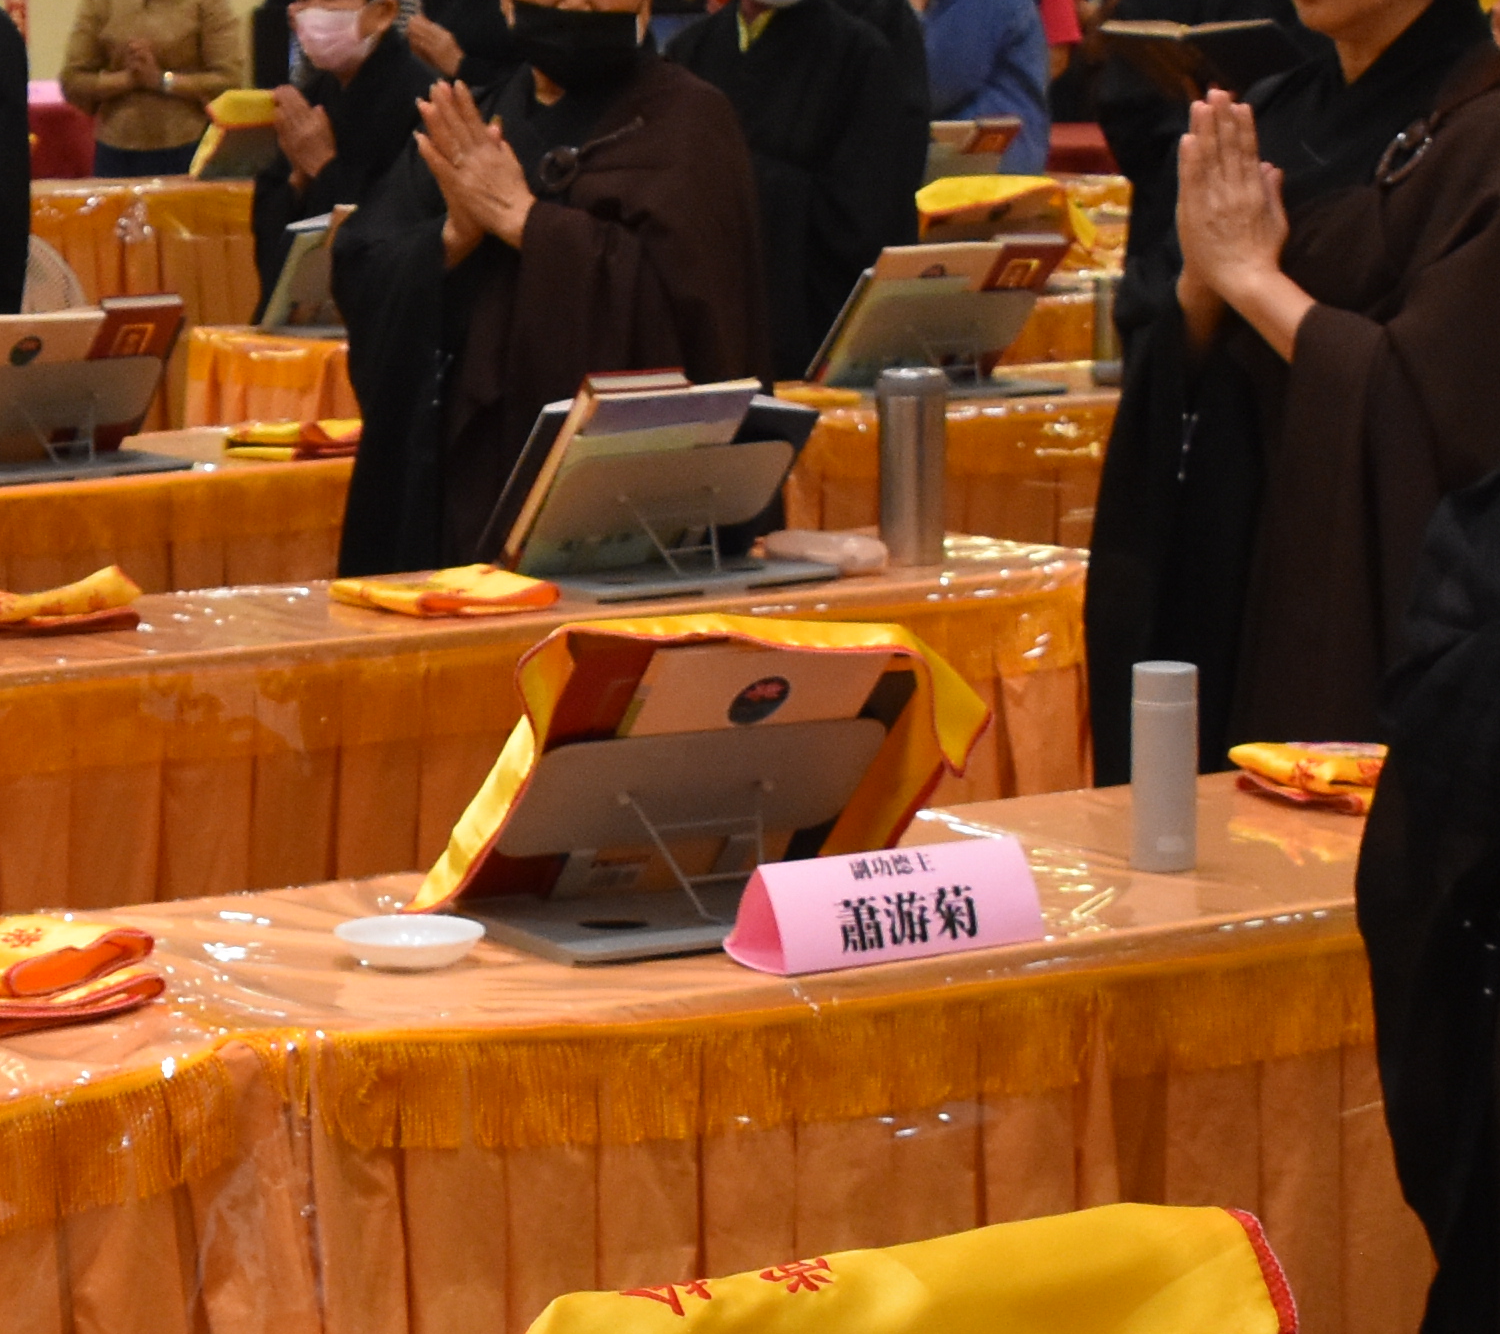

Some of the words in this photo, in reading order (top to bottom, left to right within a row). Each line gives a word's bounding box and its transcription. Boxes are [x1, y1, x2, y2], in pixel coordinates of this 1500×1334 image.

[848, 852, 936, 880] 副功德主
[834, 885, 979, 954] 蕭游菊
